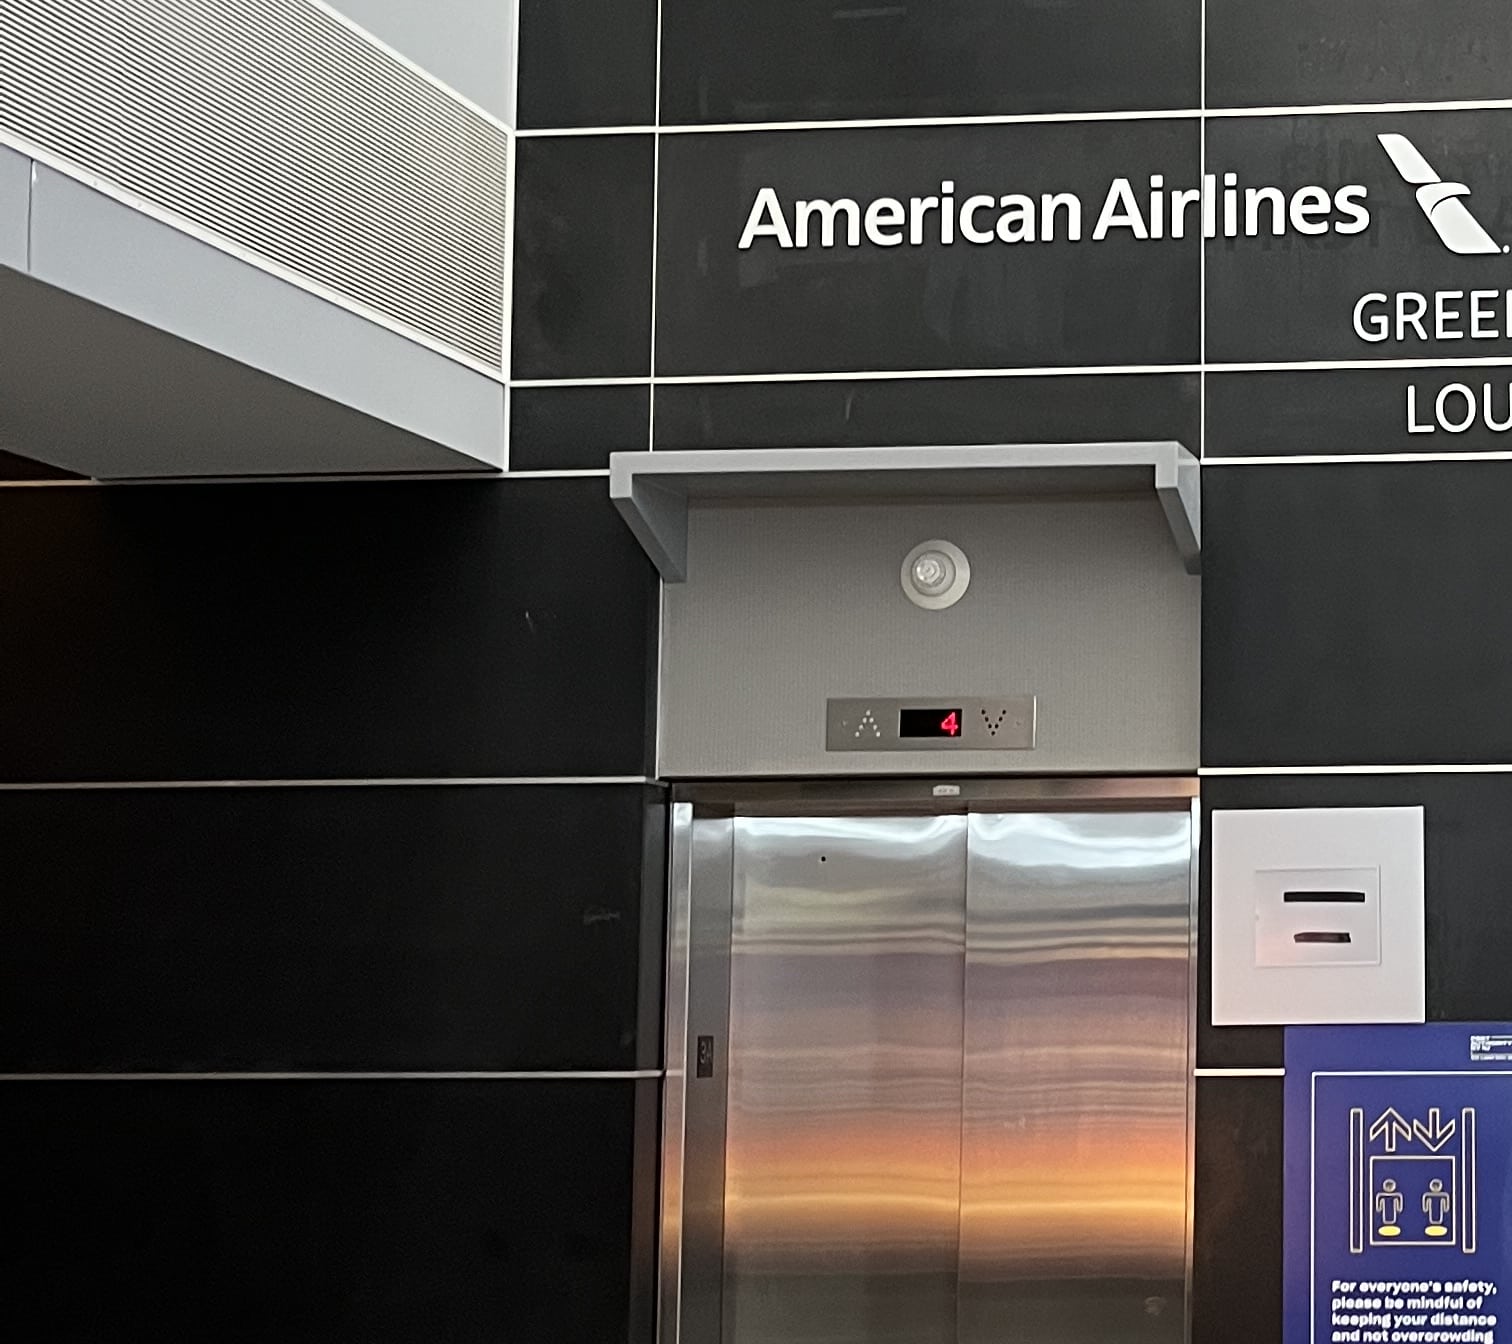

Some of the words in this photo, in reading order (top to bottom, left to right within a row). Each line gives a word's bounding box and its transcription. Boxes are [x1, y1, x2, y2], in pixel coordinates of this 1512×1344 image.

[738, 180, 1082, 249] American
[1092, 172, 1370, 242] Airlines
[941, 711, 959, 736] 4
[1332, 1280, 1357, 1293] For
[1359, 1280, 1442, 1296] everyone's
[1444, 1280, 1497, 1296] safety,
[1332, 1296, 1382, 1312] please
[1385, 1296, 1404, 1309] be
[1407, 1296, 1464, 1309] mindful
[1466, 1296, 1483, 1309] of
[1332, 1313, 1391, 1328] keeping
[1394, 1315, 1427, 1328] your
[1430, 1312, 1497, 1326] distance
[1332, 1330, 1360, 1342] and
[1363, 1330, 1389, 1342] not
[1391, 1329, 1494, 1344] overcrowding
